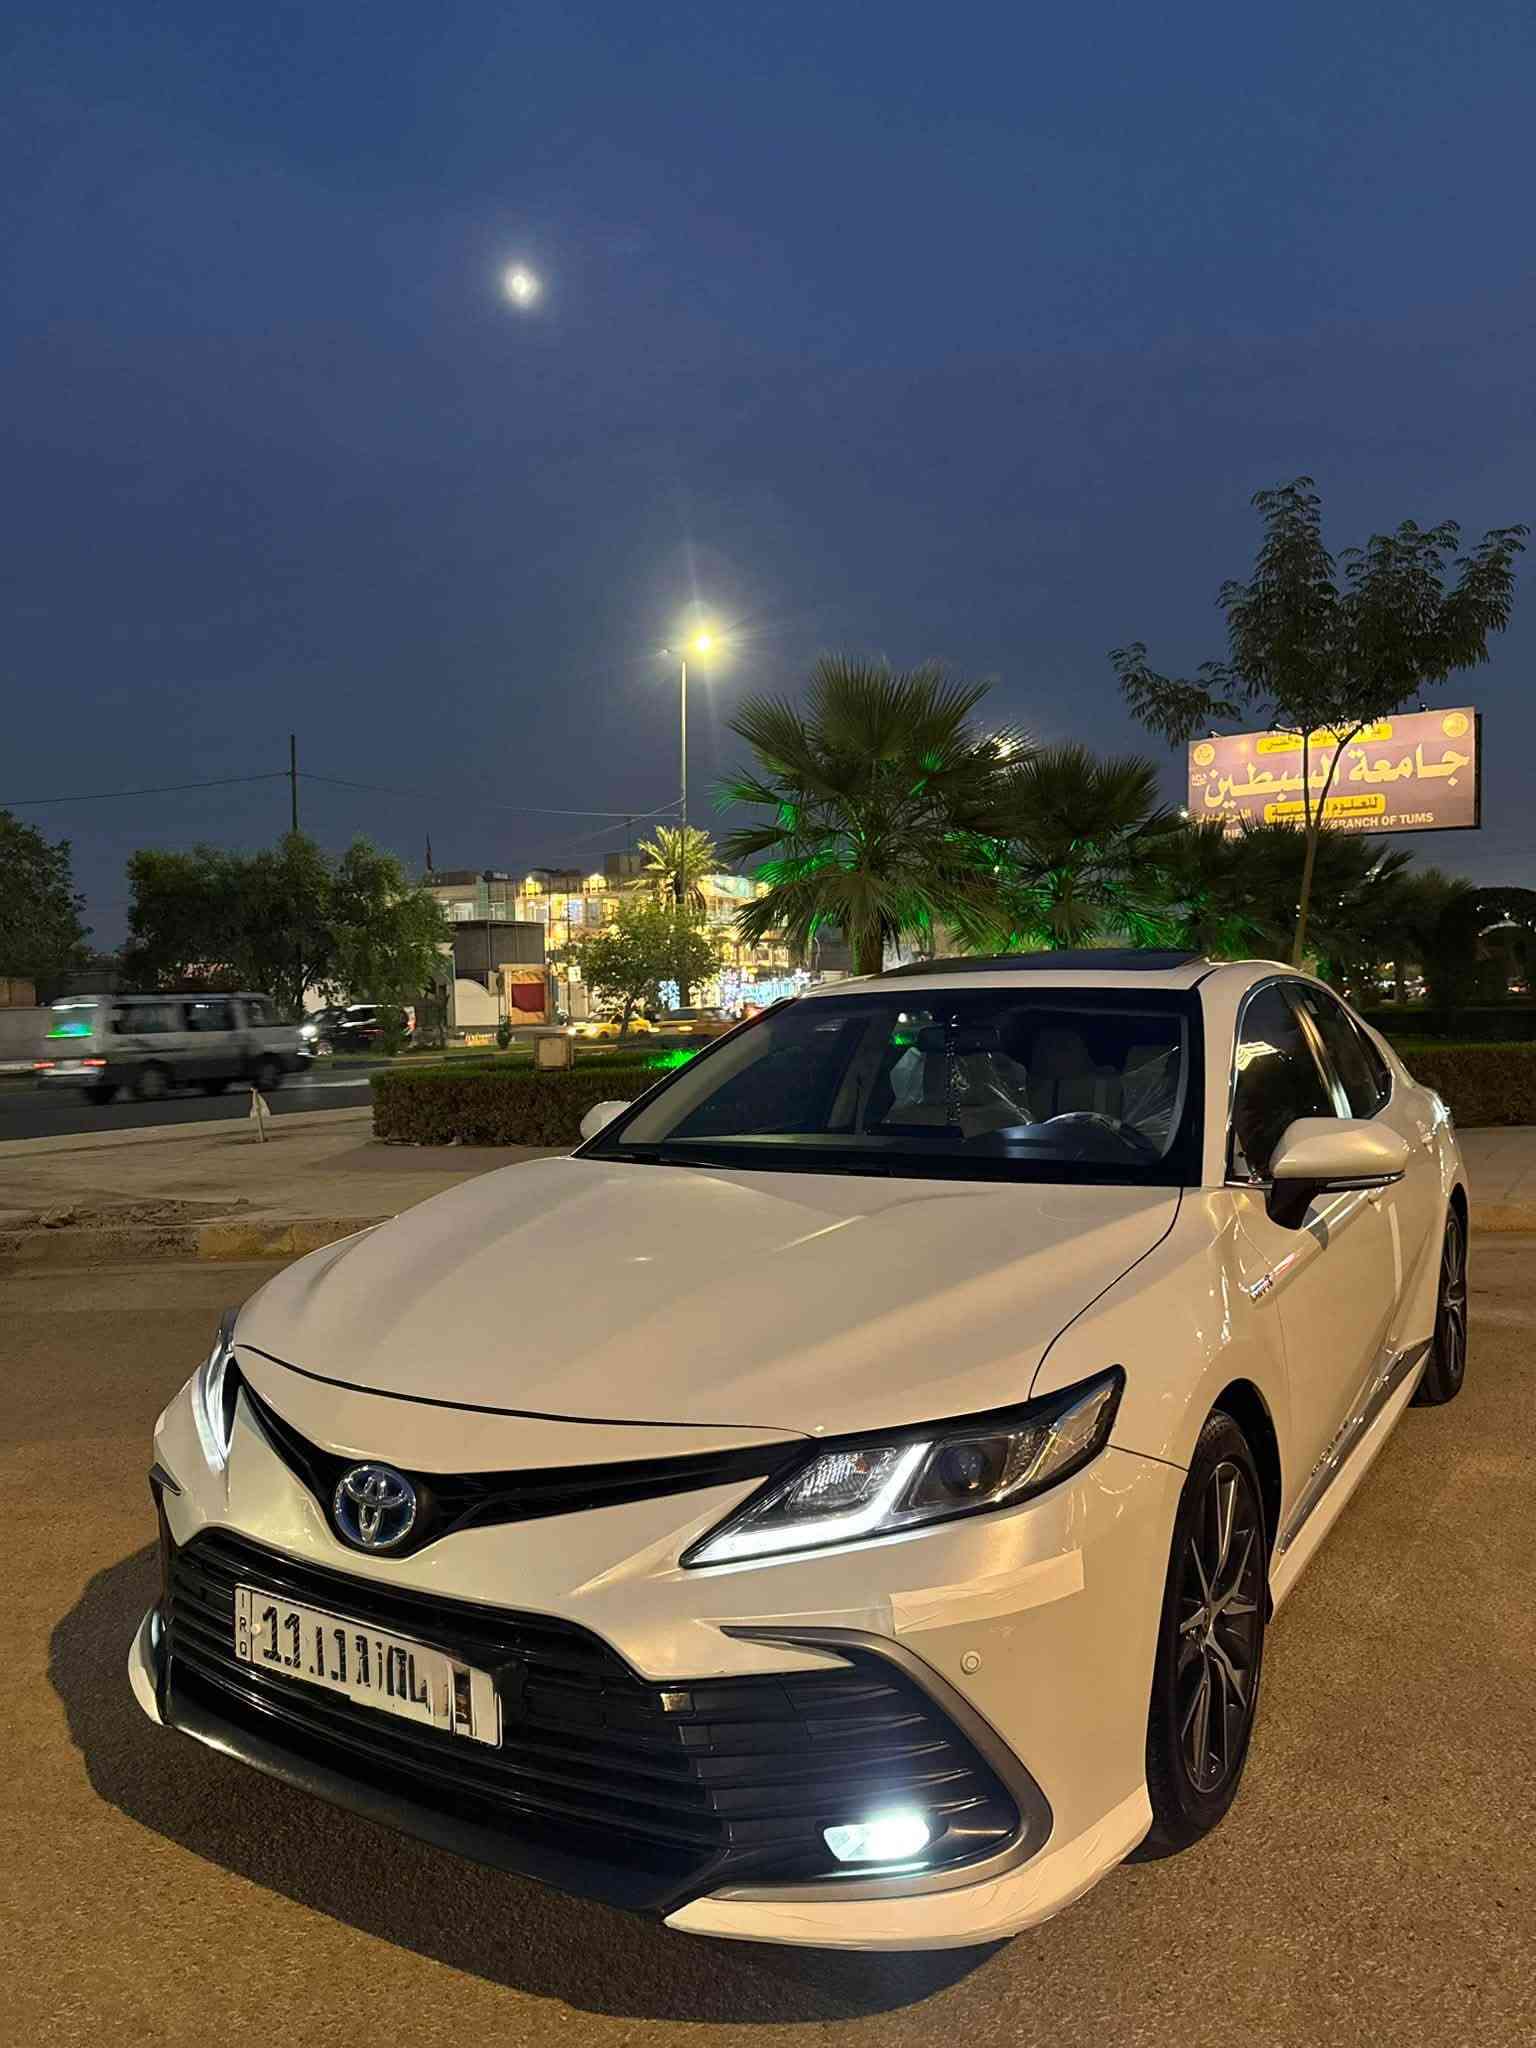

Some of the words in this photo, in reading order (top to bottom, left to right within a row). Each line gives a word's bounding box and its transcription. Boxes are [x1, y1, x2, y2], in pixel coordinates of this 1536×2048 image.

[1347, 743, 1470, 786] جامعة
[1381, 814, 1397, 825] OF
[1400, 813, 1434, 825] TUMS
[239, 1592, 248, 1656] IRQ
